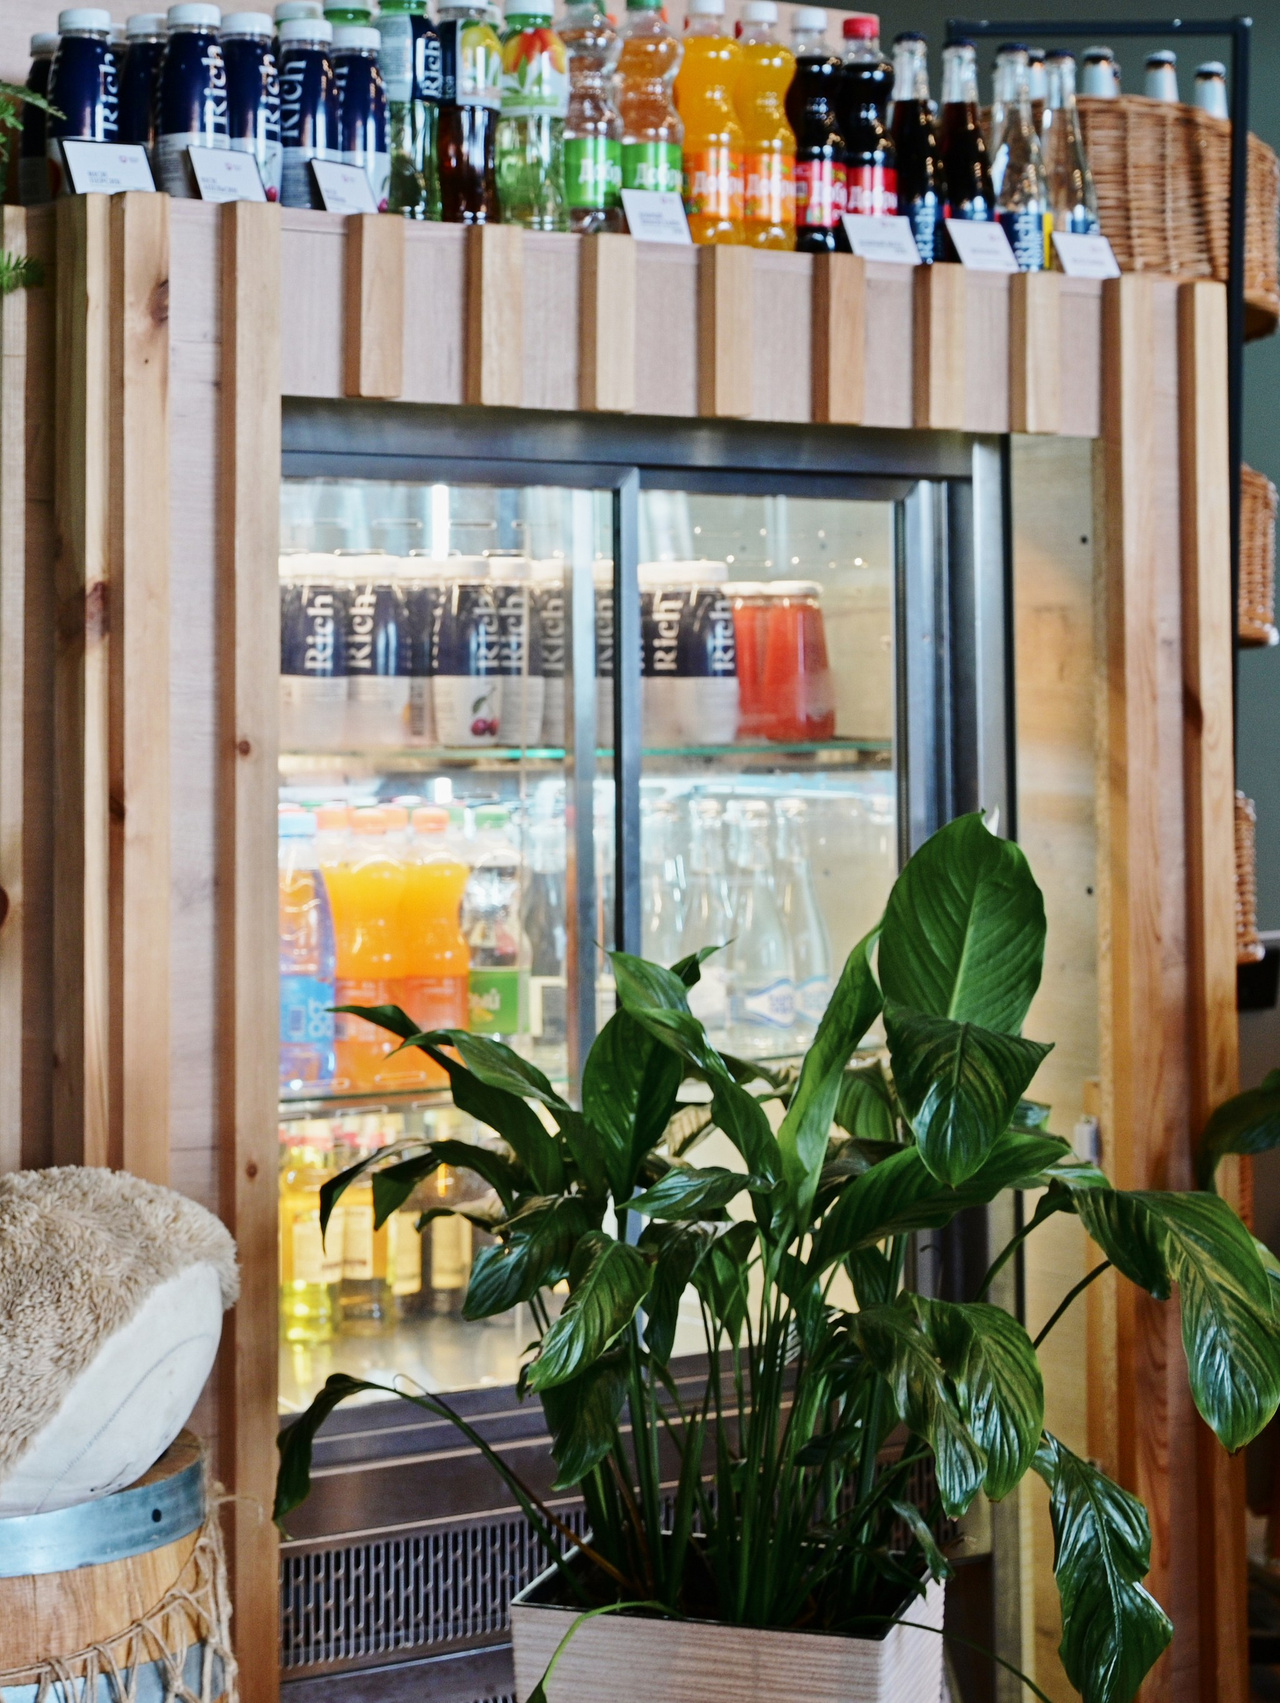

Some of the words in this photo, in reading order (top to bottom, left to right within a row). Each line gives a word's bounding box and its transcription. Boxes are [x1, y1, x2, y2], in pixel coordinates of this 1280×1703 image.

[96, 53, 118, 131] Rich
[201, 45, 227, 124] Rich
[258, 54, 280, 132] Rich
[422, 40, 442, 98] Rich
[304, 594, 334, 669] Rich
[346, 594, 377, 669] Rich
[473, 594, 500, 668] Rich
[500, 594, 524, 668] Rich
[651, 600, 684, 670] Rich
[709, 599, 735, 670] Rich
